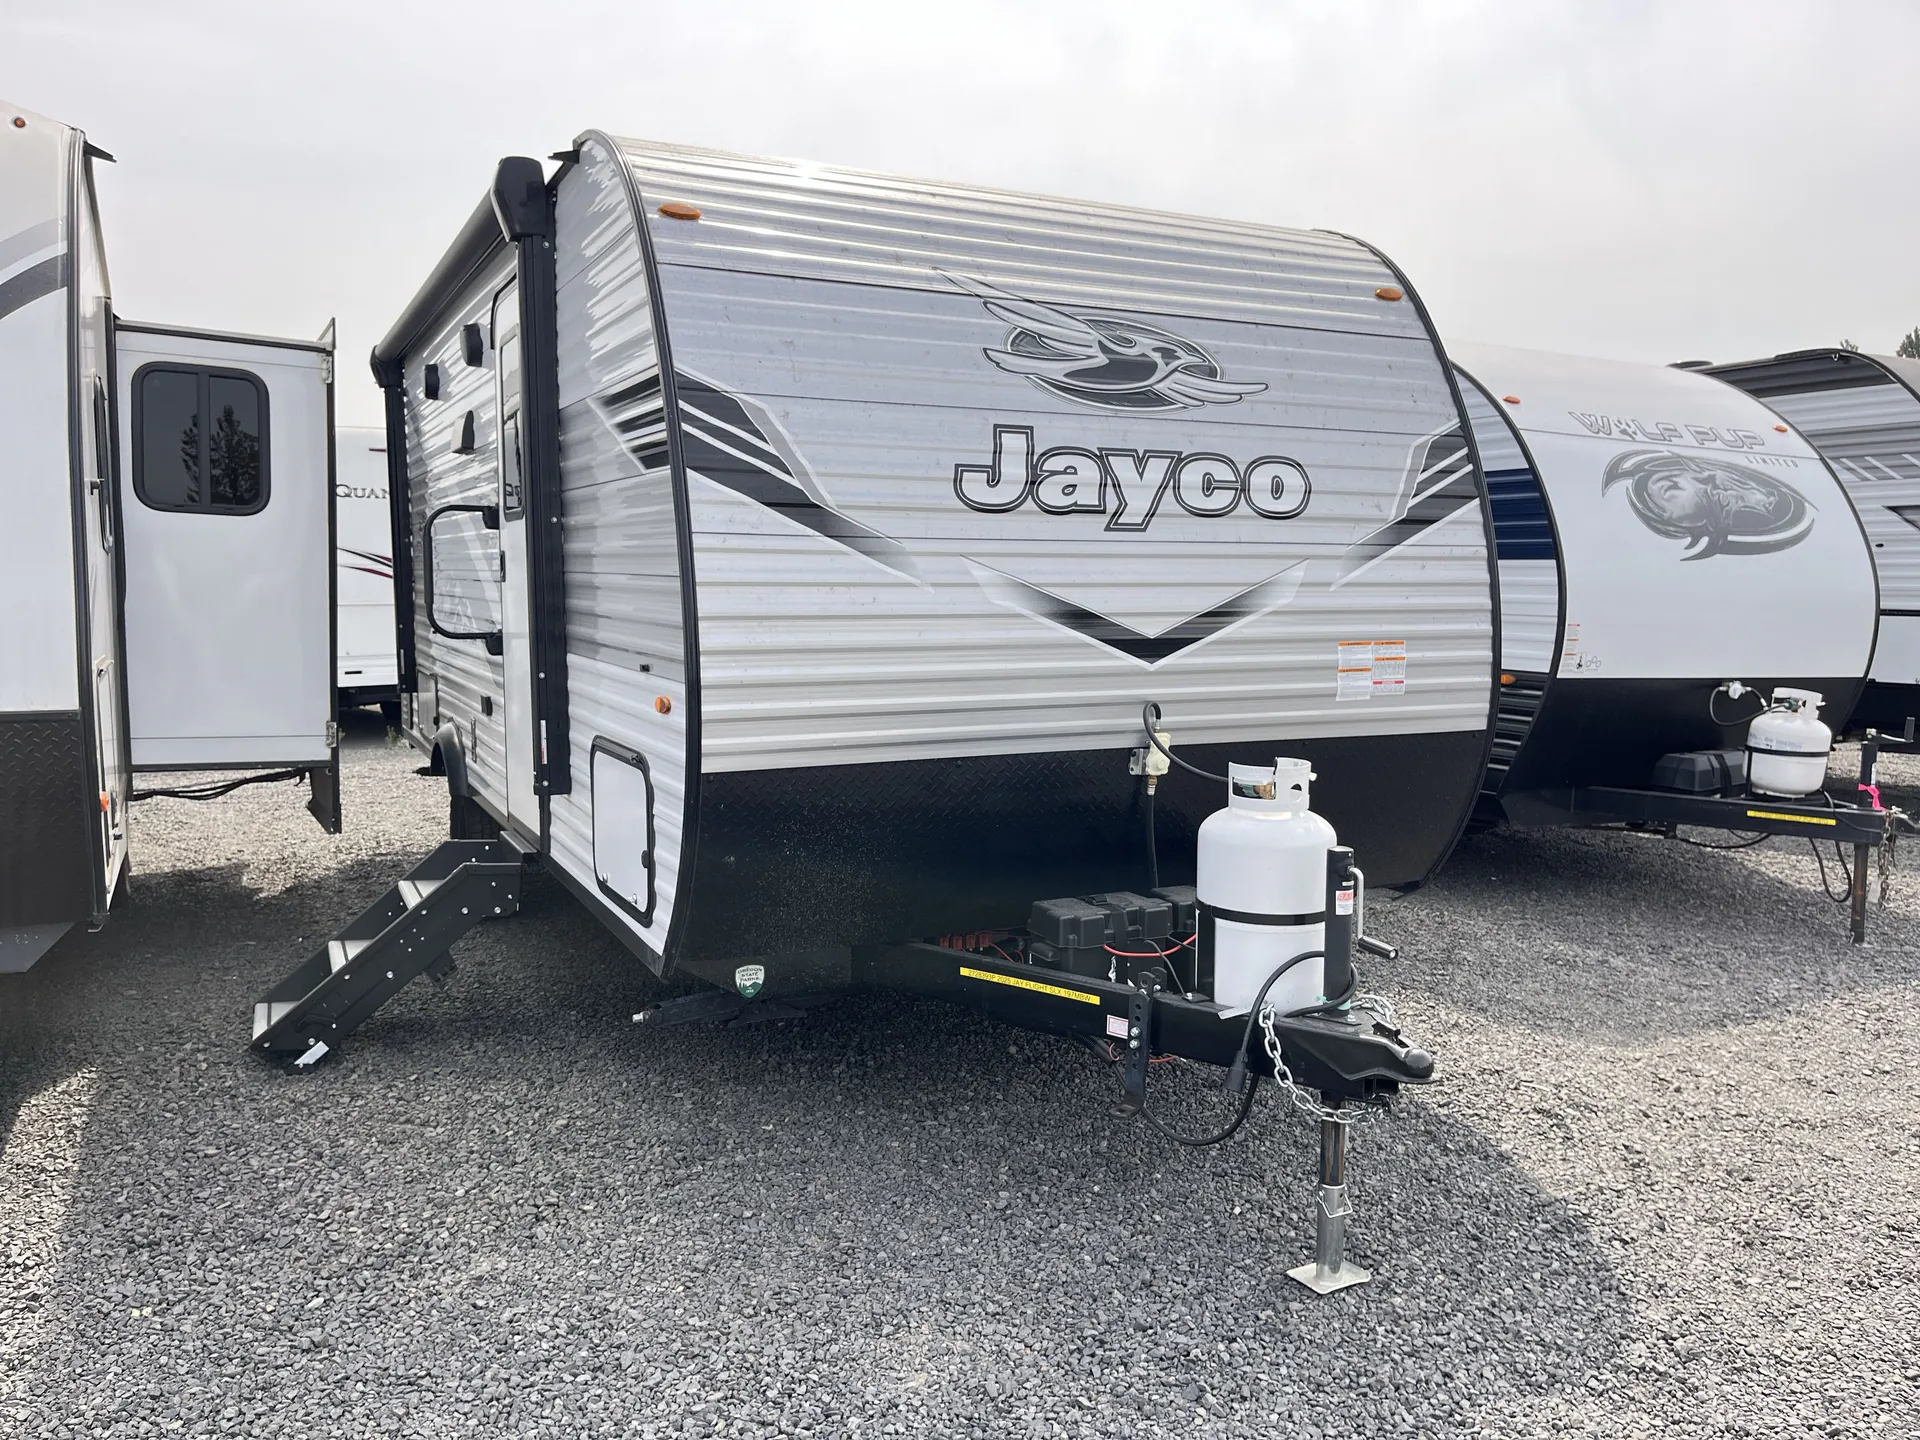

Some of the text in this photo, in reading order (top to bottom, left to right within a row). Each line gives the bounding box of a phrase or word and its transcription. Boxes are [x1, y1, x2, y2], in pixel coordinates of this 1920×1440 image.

[1684, 424, 1765, 450] PUP
[1745, 455, 1799, 468] LIMITED
[953, 423, 1312, 532] Jayco
[1012, 978, 1025, 987] JAY
[1025, 982, 1048, 992] FLIGHT
[1049, 986, 1062, 994] SLX
